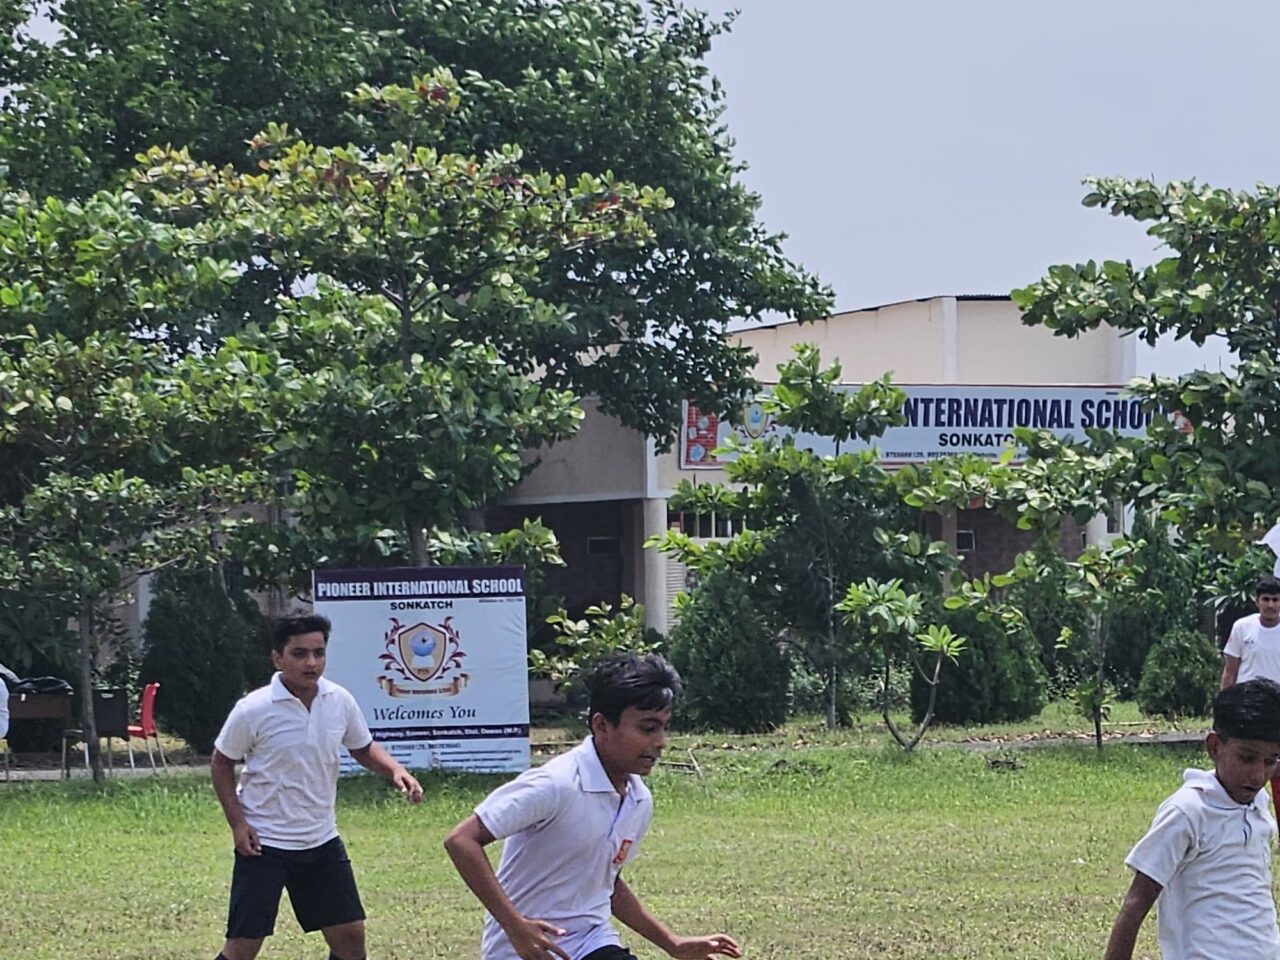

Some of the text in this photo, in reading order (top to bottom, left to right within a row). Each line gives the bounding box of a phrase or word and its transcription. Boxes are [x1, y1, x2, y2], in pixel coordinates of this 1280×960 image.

[904, 398, 1166, 430] NTERNATIONAL SCHO
[938, 433, 1019, 447] SONKATC
[317, 578, 523, 597] PIONEER INTERNATIONAL SCHOOL
[390, 600, 453, 610] SONKATCH
[373, 705, 476, 721] Welcomes You
